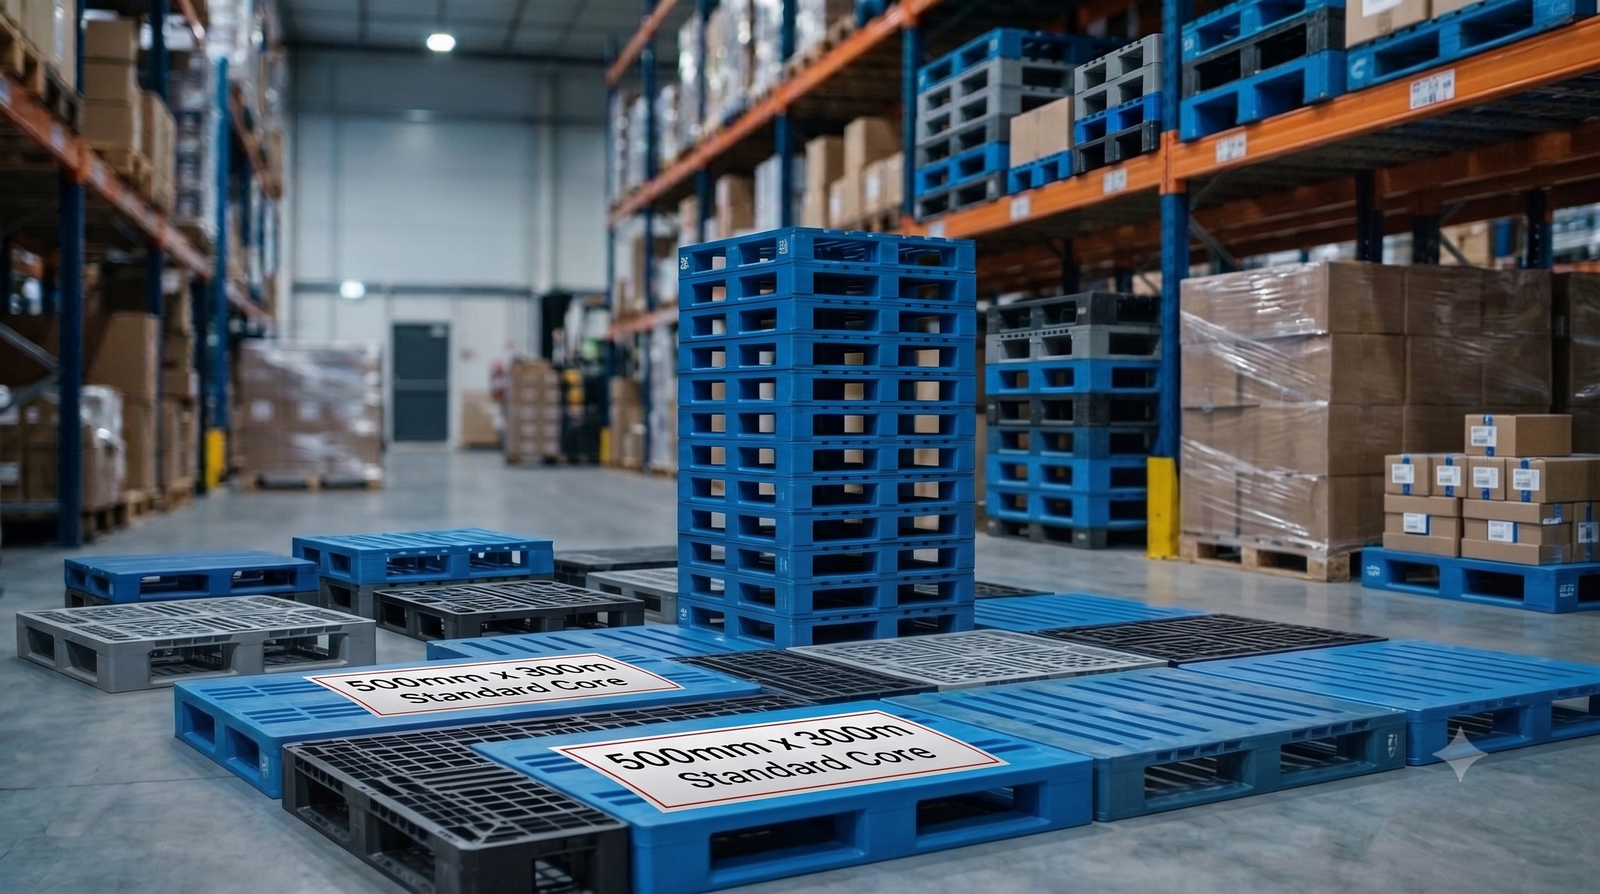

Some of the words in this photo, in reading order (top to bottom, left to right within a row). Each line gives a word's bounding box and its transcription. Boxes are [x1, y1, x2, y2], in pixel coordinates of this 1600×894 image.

[346, 672, 489, 692] 500mm
[490, 670, 520, 680] x
[515, 662, 616, 677] 300m
[400, 682, 550, 705] Standard
[550, 675, 629, 690] Core
[605, 738, 773, 771] 500mm
[769, 737, 805, 751] x
[794, 724, 914, 746] 300m
[677, 756, 853, 788] Standard
[845, 748, 937, 766] Core
